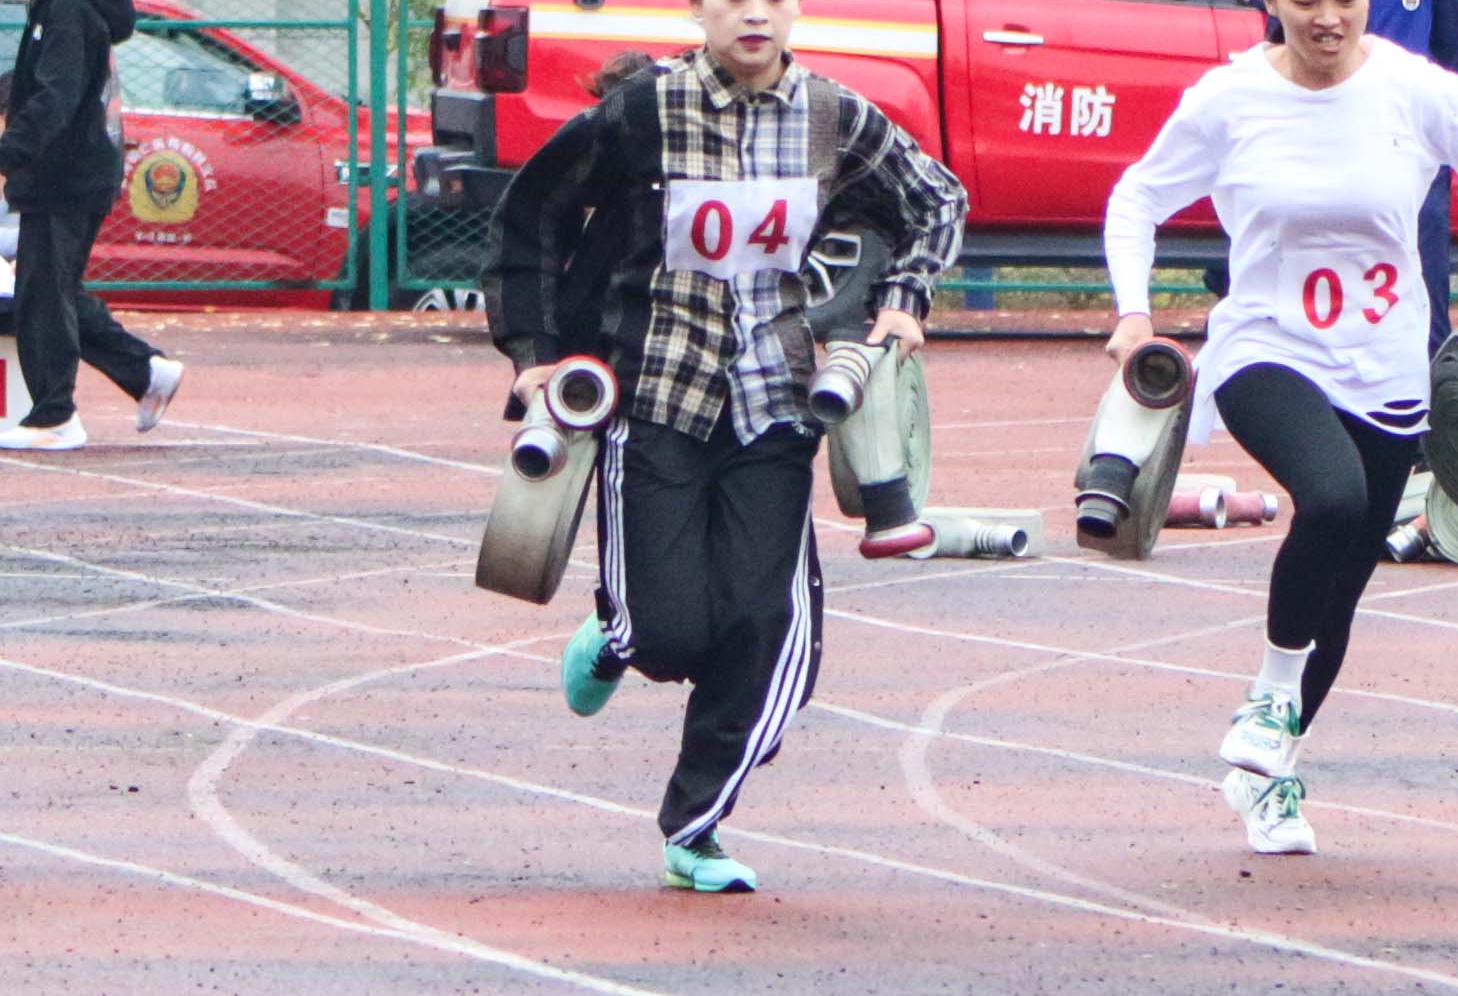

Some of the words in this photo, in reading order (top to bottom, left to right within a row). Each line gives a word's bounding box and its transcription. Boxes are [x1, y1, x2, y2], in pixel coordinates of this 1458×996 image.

[1019, 83, 1116, 137] 消防
[690, 199, 790, 261] 04
[1302, 263, 1399, 330] 03
